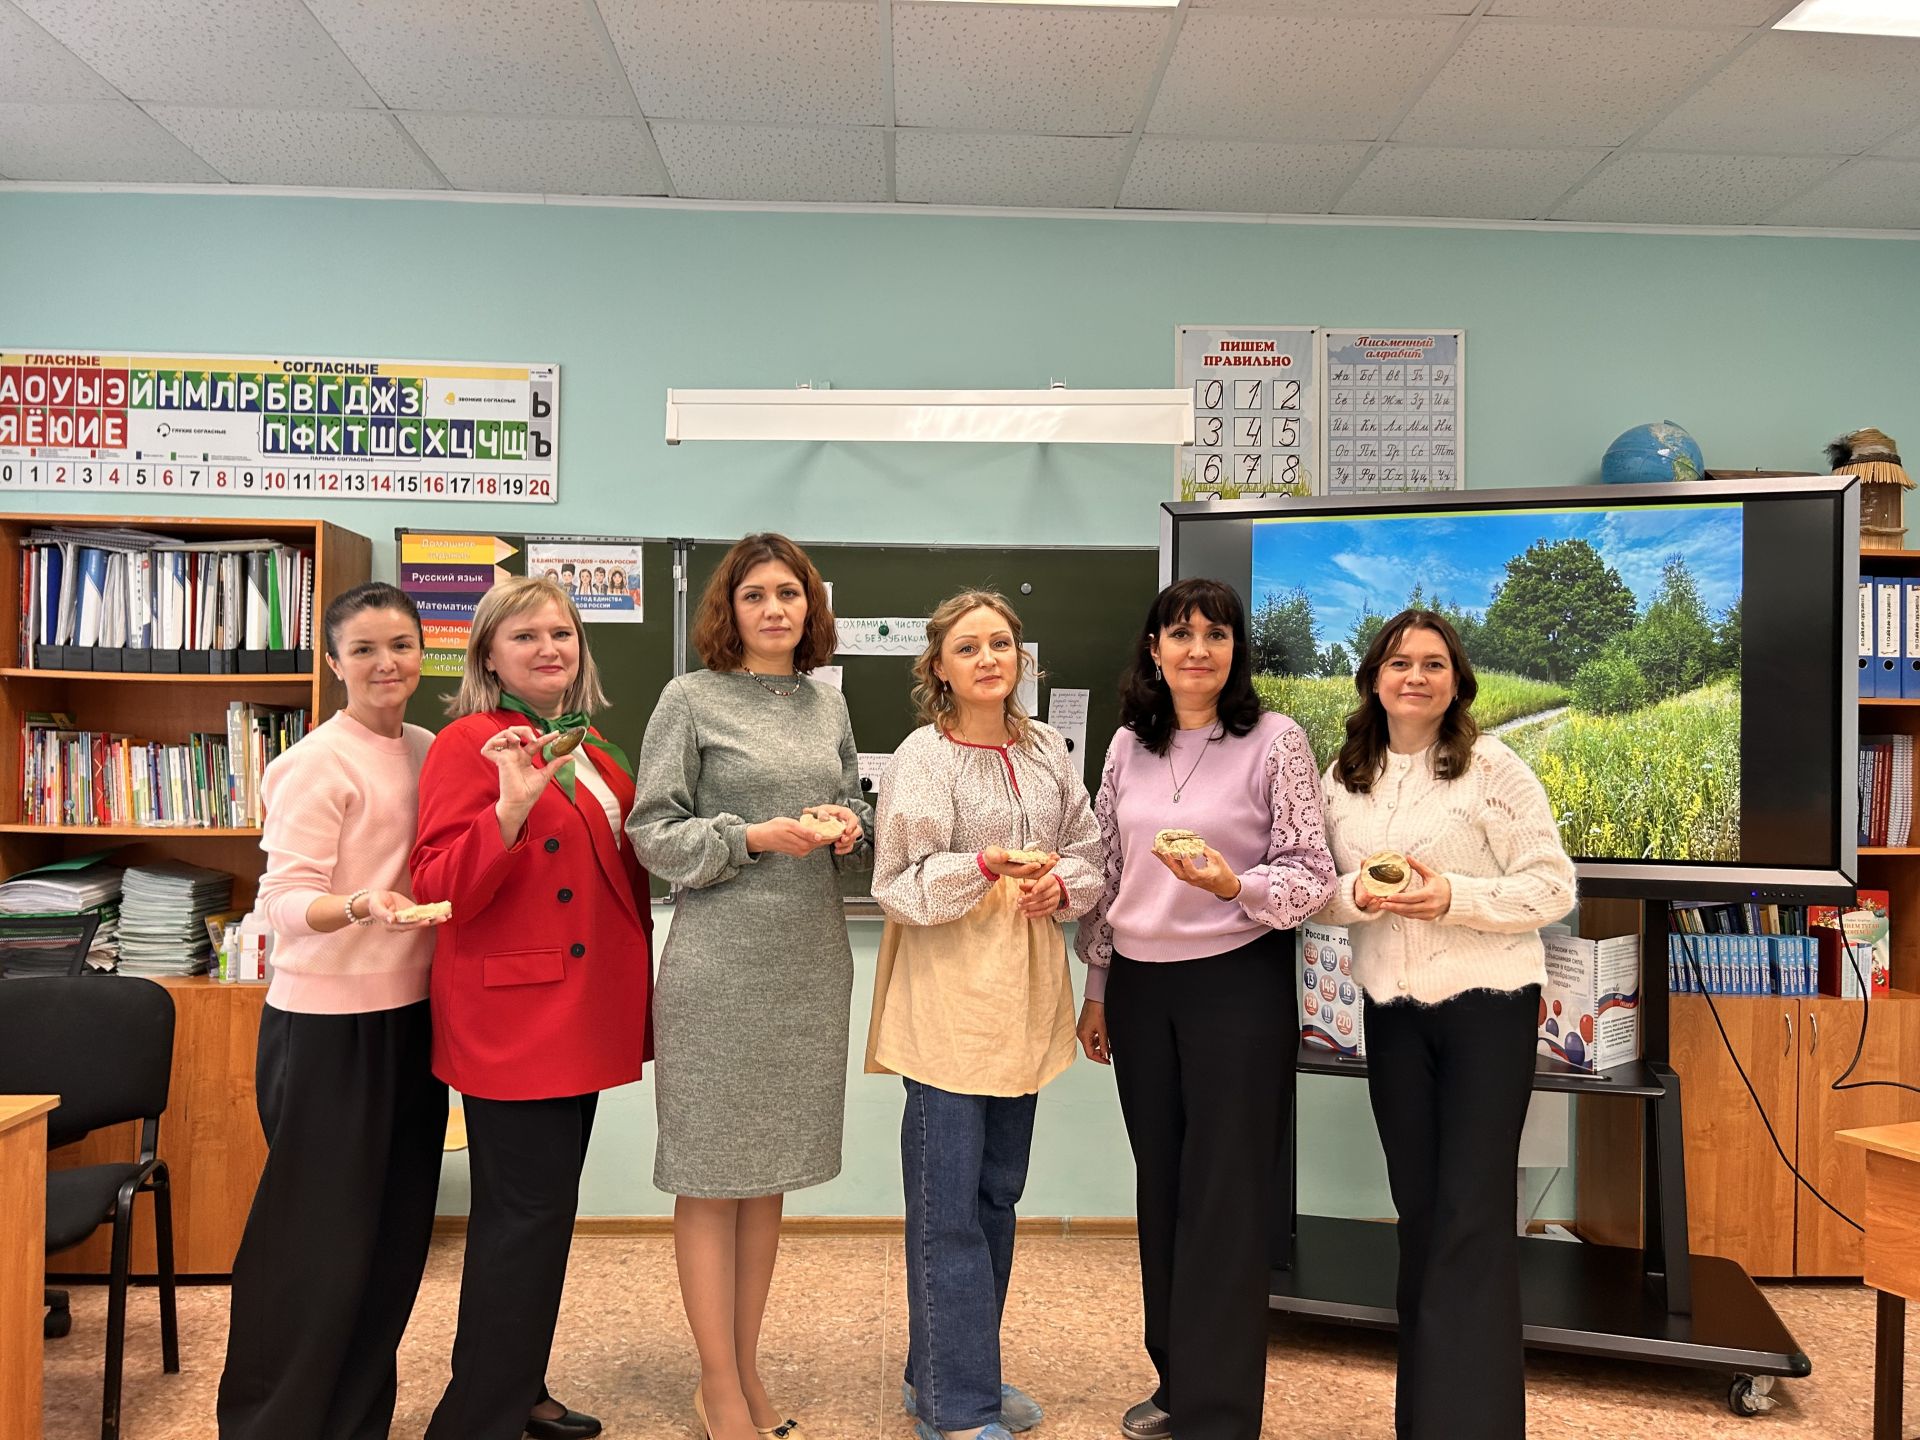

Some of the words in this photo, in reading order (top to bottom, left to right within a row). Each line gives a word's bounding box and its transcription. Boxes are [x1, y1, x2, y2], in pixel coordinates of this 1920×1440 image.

[1220, 342, 1275, 352] ПИШЕМ
[1354, 336, 1434, 348] Письменный
[25, 354, 100, 366] ГЛАСНЫЕ
[1366, 348, 1422, 360] алфавит
[1204, 356, 1291, 366] ПРАВИЛЬНО
[283, 361, 379, 375] СОГЛАСНЫЕ
[0, 375, 19, 402] А
[25, 378, 46, 404] О
[52, 376, 73, 404] У
[77, 377, 99, 406] Ы
[106, 378, 125, 406] Э
[133, 372, 152, 407] Й
[160, 379, 180, 407] Н
[185, 380, 207, 408] М
[211, 381, 234, 409] Л
[240, 382, 259, 409] Р
[267, 383, 286, 410] Б
[294, 384, 312, 411] В
[322, 384, 338, 412] Г
[345, 385, 368, 414] Д
[371, 386, 396, 413] Ж
[401, 386, 419, 414] З
[1205, 380, 1223, 409] 0
[1249, 380, 1262, 409] 1
[1281, 380, 1300, 410] 2
[0, 415, 17, 442] Я
[28, 408, 43, 443] Ё
[50, 417, 73, 444] Ю
[78, 418, 98, 445] И
[106, 418, 122, 445] Е
[266, 423, 285, 451] П
[292, 424, 315, 451] Ф
[321, 424, 340, 452] К
[347, 426, 367, 452] Т
[371, 426, 395, 453] Ш
[399, 426, 417, 453] С
[425, 427, 445, 455] Х
[450, 428, 472, 458] Ц
[479, 428, 496, 457] Ч
[504, 430, 527, 460] Щ
[531, 431, 551, 457] Ъ
[1203, 418, 1222, 446] 3
[1246, 418, 1262, 446] 4
[1279, 418, 1300, 446] 5
[1204, 454, 1222, 483] 6
[1243, 454, 1262, 483] 7
[1282, 455, 1299, 483] 8
[2, 465, 13, 482] 0
[30, 466, 38, 482] 1
[56, 466, 66, 483] 2
[83, 467, 93, 483] 3
[109, 468, 120, 484] 4
[136, 469, 146, 485] 5
[163, 470, 173, 486] 6
[190, 471, 200, 487] 7
[217, 471, 227, 487] 8
[243, 472, 254, 488] 9
[265, 472, 285, 489] 10
[293, 474, 311, 490] 11
[318, 474, 338, 490] 12
[345, 475, 365, 491] 13
[371, 476, 391, 492] 14
[397, 476, 418, 493] 15
[424, 476, 444, 493] 16
[450, 477, 471, 494] 17
[477, 478, 496, 494] 18
[503, 479, 523, 495] 19
[529, 479, 549, 496] 20
[412, 572, 454, 584] Русский
[416, 600, 478, 612] Математика
[422, 626, 472, 634] кружающ
[836, 620, 888, 630] СОХРАНИМ
[856, 634, 860, 642] С
[865, 634, 926, 643] БЕЗЗУБИКОМ
[423, 653, 466, 662] итерату
[1305, 928, 1330, 942] Россия
[1322, 950, 1335, 962] 190
[1307, 973, 1314, 982] 13
[1322, 980, 1335, 992] 146
[1343, 984, 1352, 995] 16
[1338, 1016, 1352, 1027] 270
